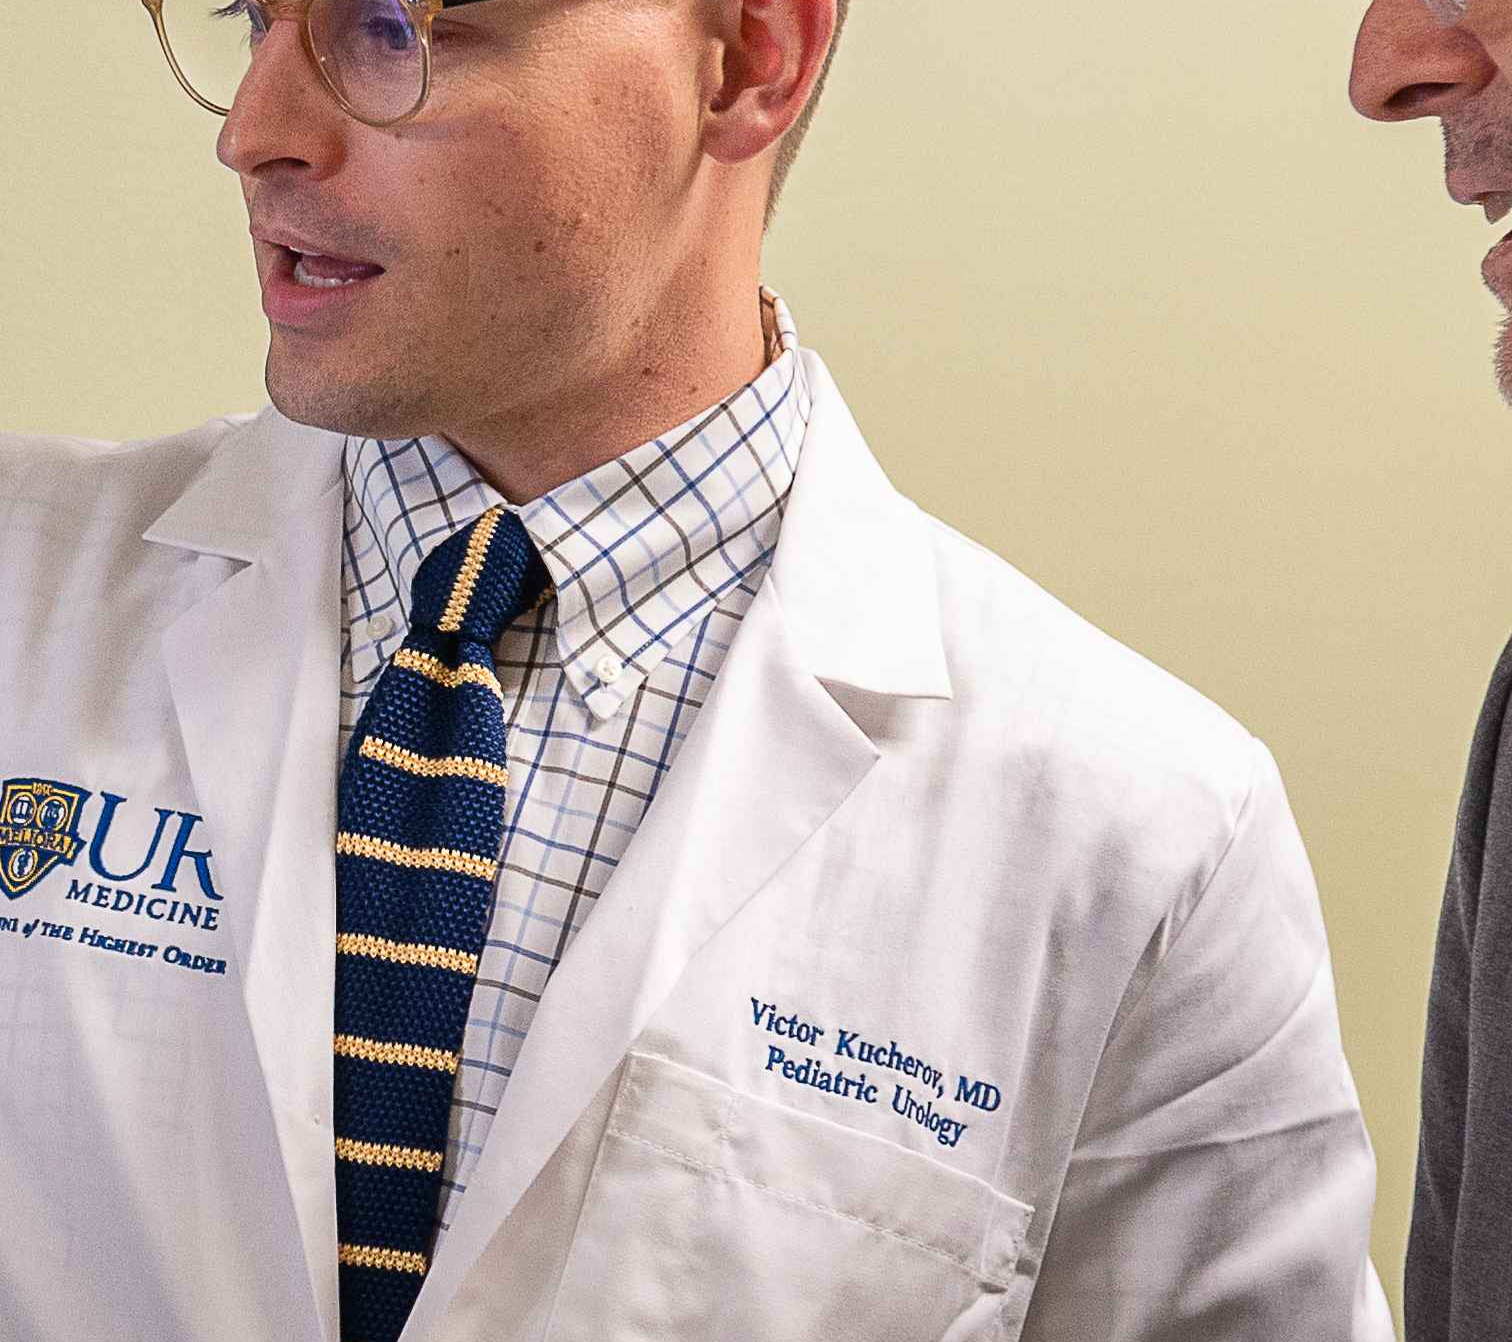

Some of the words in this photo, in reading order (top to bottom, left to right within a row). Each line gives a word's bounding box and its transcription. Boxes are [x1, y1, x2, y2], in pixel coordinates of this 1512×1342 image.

[66, 879, 219, 931] MEDICINE
[41, 921, 73, 941] THE
[77, 925, 159, 959] HIGHEST
[163, 945, 227, 975] ORDER
[750, 997, 824, 1046] Victor
[835, 1029, 946, 1098] Kucherov,
[955, 1075, 1002, 1113] MD
[765, 1045, 877, 1104] Pediatric
[892, 1083, 968, 1148] Urology
